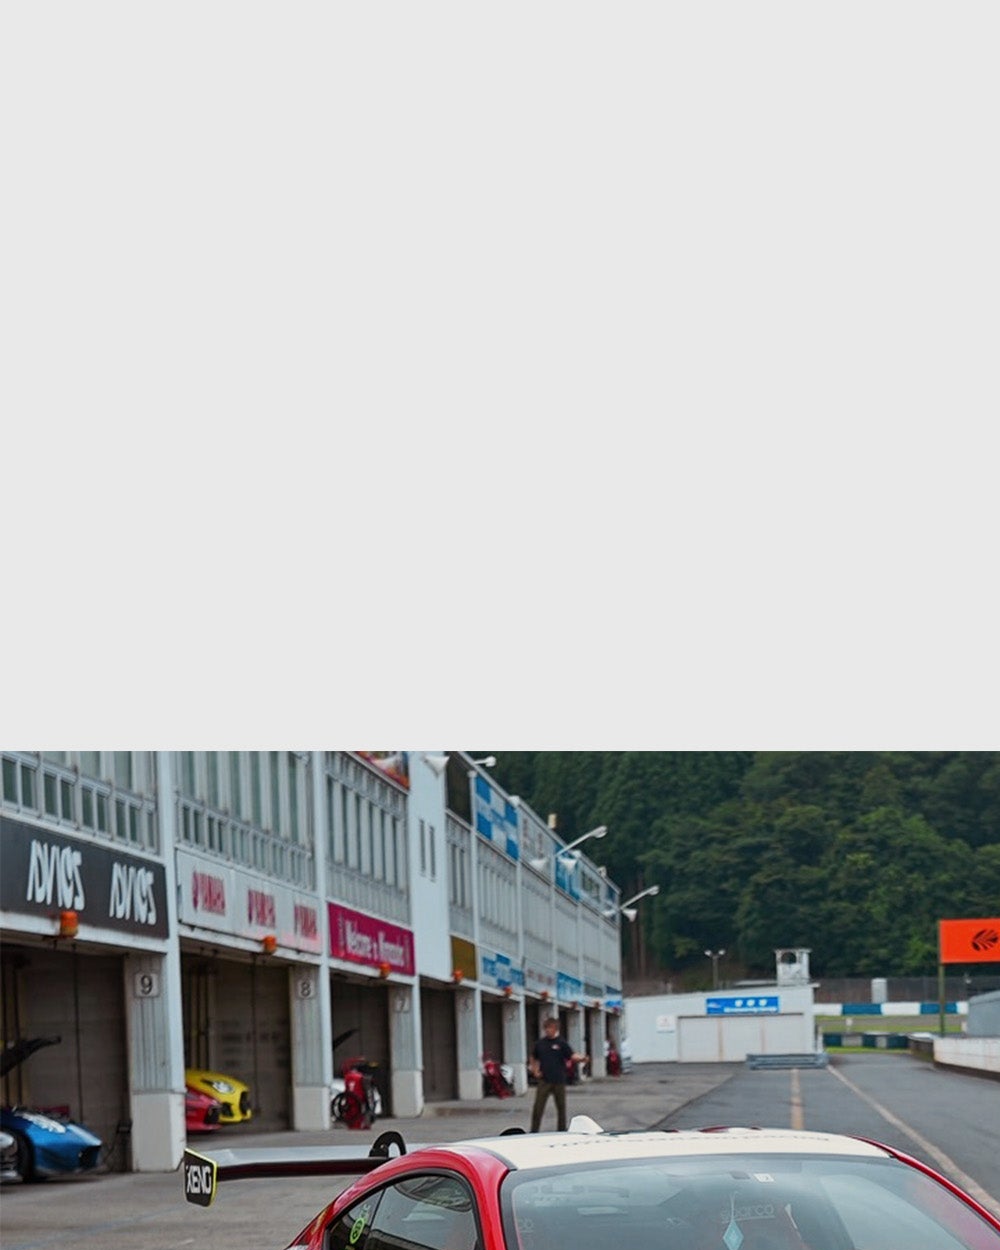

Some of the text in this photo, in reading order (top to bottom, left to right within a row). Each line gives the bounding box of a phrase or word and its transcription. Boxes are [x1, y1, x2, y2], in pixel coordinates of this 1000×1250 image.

[141, 975, 153, 995] 9
[301, 981, 311, 998] 8
[186, 1165, 212, 1194] XENO
